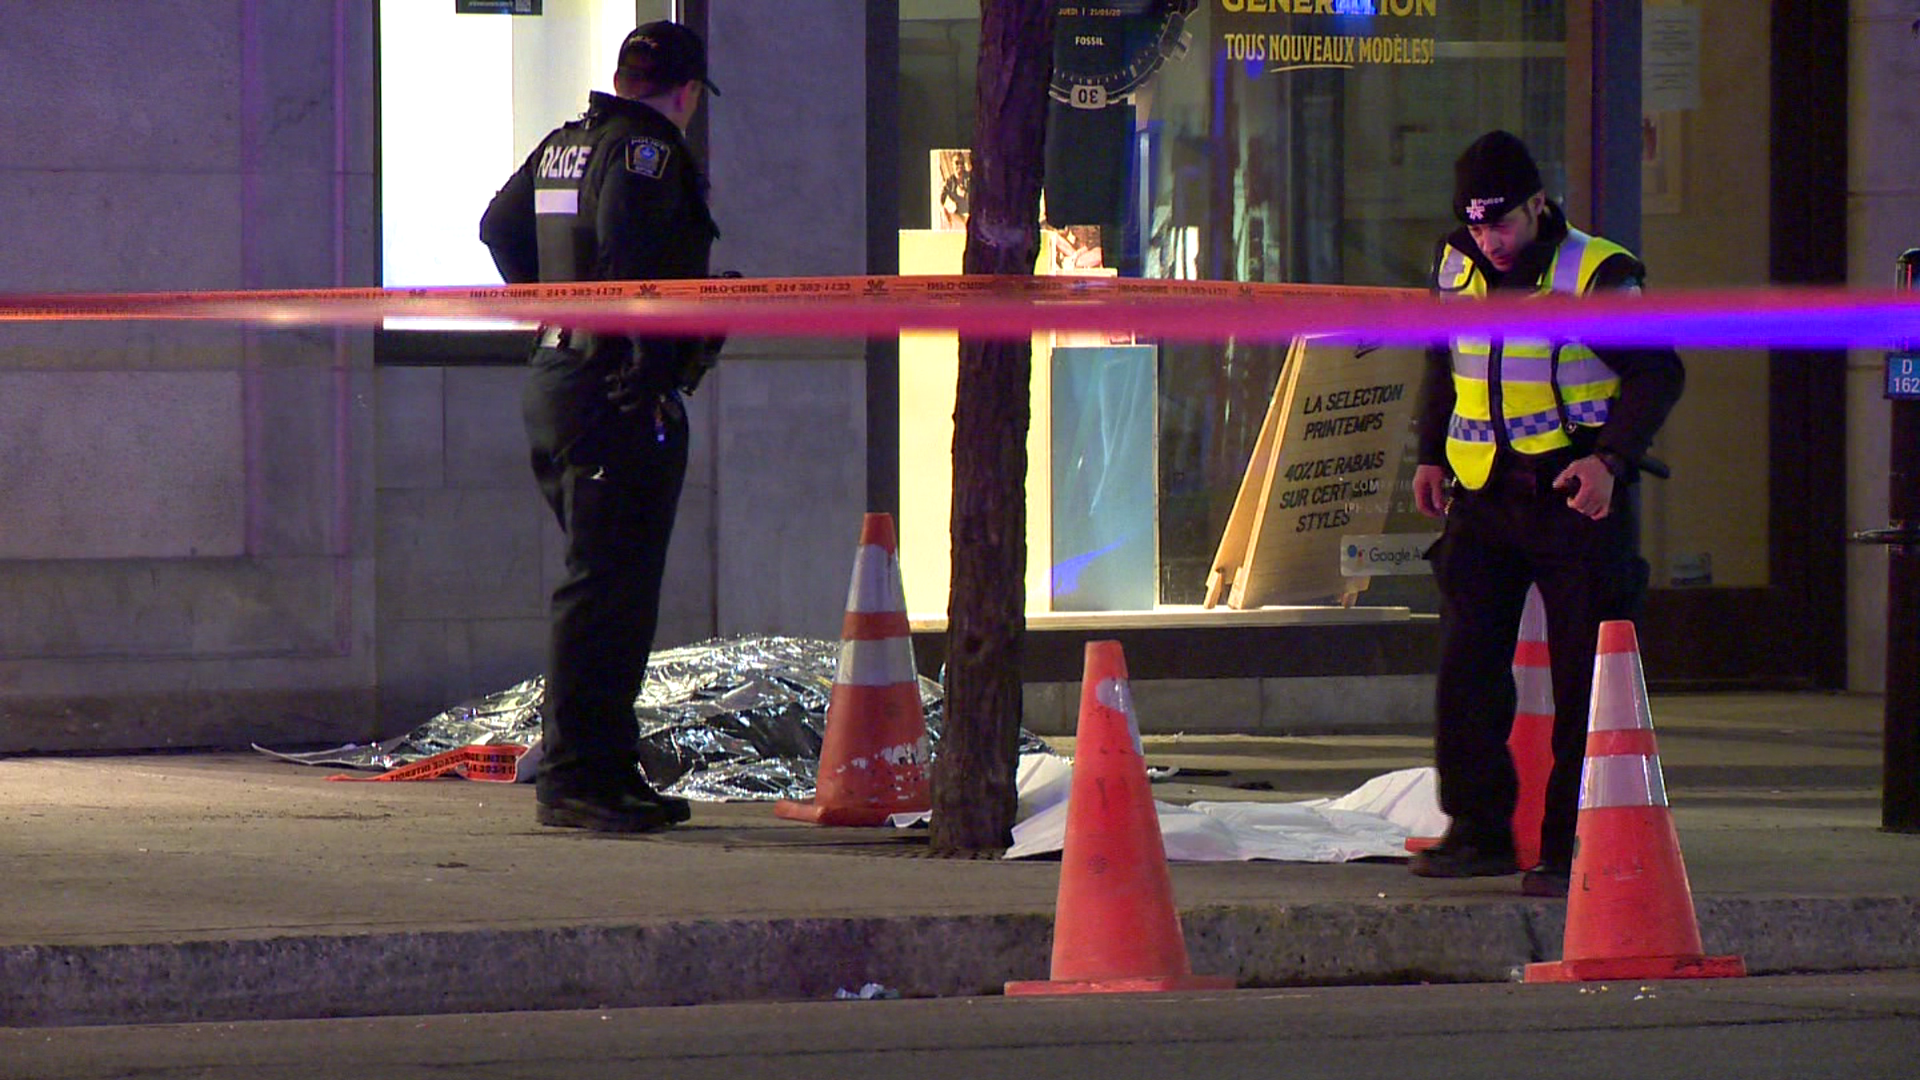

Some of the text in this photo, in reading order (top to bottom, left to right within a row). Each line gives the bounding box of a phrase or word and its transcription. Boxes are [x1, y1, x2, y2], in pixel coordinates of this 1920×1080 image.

[1075, 36, 1104, 46] FOSSIL
[1224, 34, 1435, 64] TOUS NOUVEAUX MODÈLES!
[1902, 358, 1913, 375] D
[1894, 377, 1920, 393] 162
[1303, 383, 1404, 415] LA SELECTION
[1303, 413, 1384, 441] PRINTEMPS
[1284, 451, 1385, 482] 40% DE RABAIS
[1280, 488, 1309, 509] SUR
[1295, 508, 1350, 532] STYLES
[1369, 546, 1410, 565] Google
